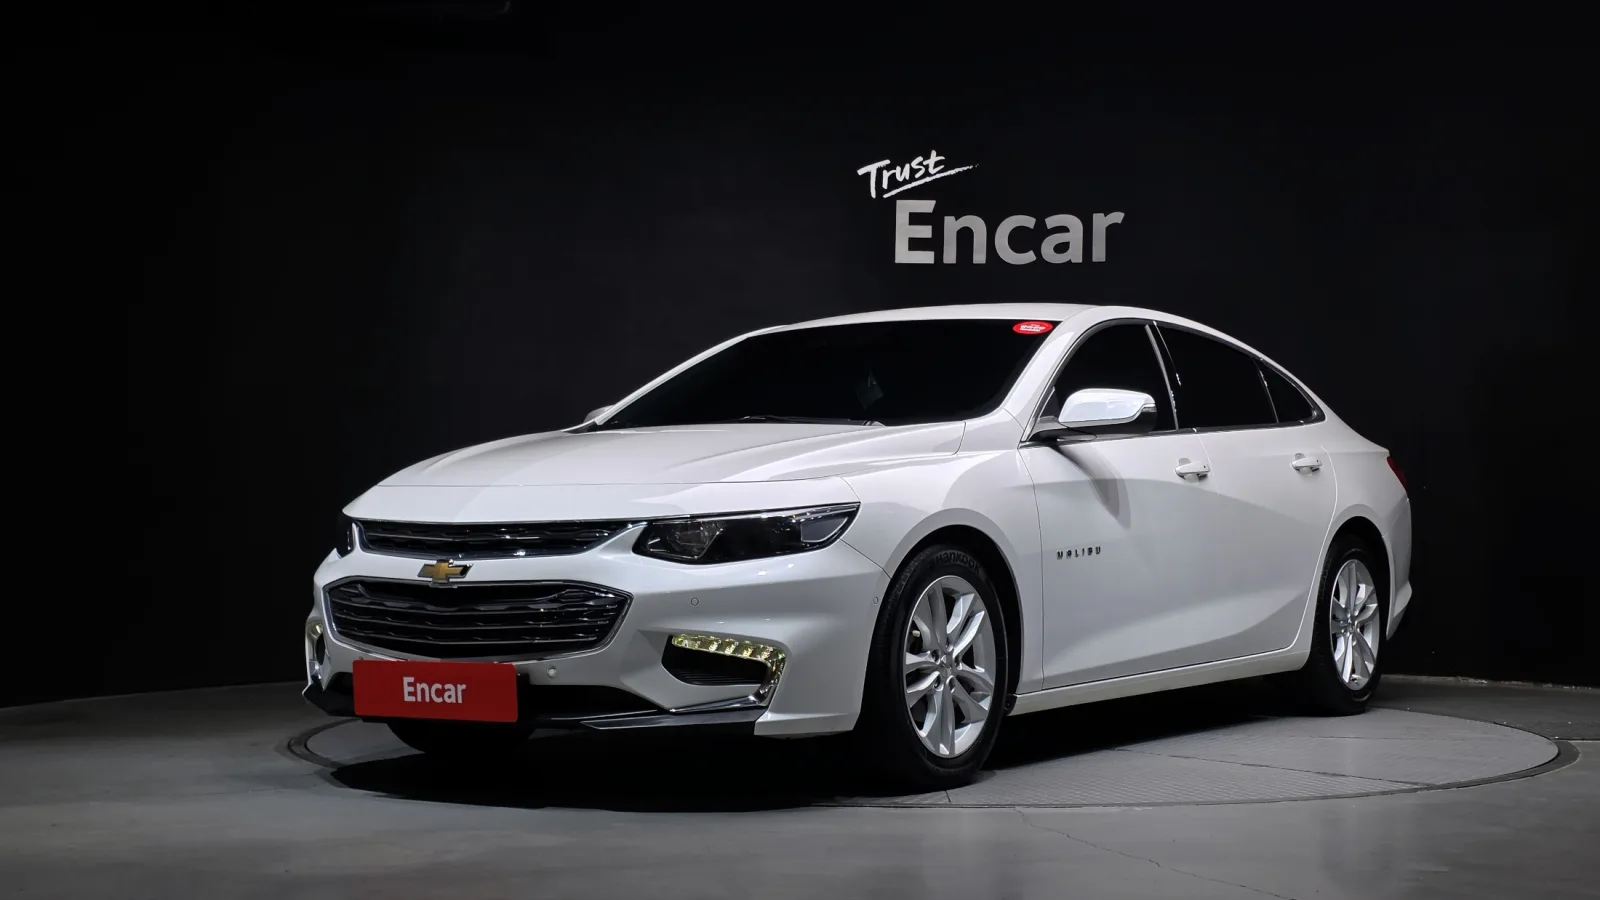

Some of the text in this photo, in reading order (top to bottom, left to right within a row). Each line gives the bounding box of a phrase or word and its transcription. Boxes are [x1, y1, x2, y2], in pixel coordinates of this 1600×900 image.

[857, 150, 946, 199] Trust
[894, 199, 1125, 265] Encar
[402, 676, 466, 704] Encar
